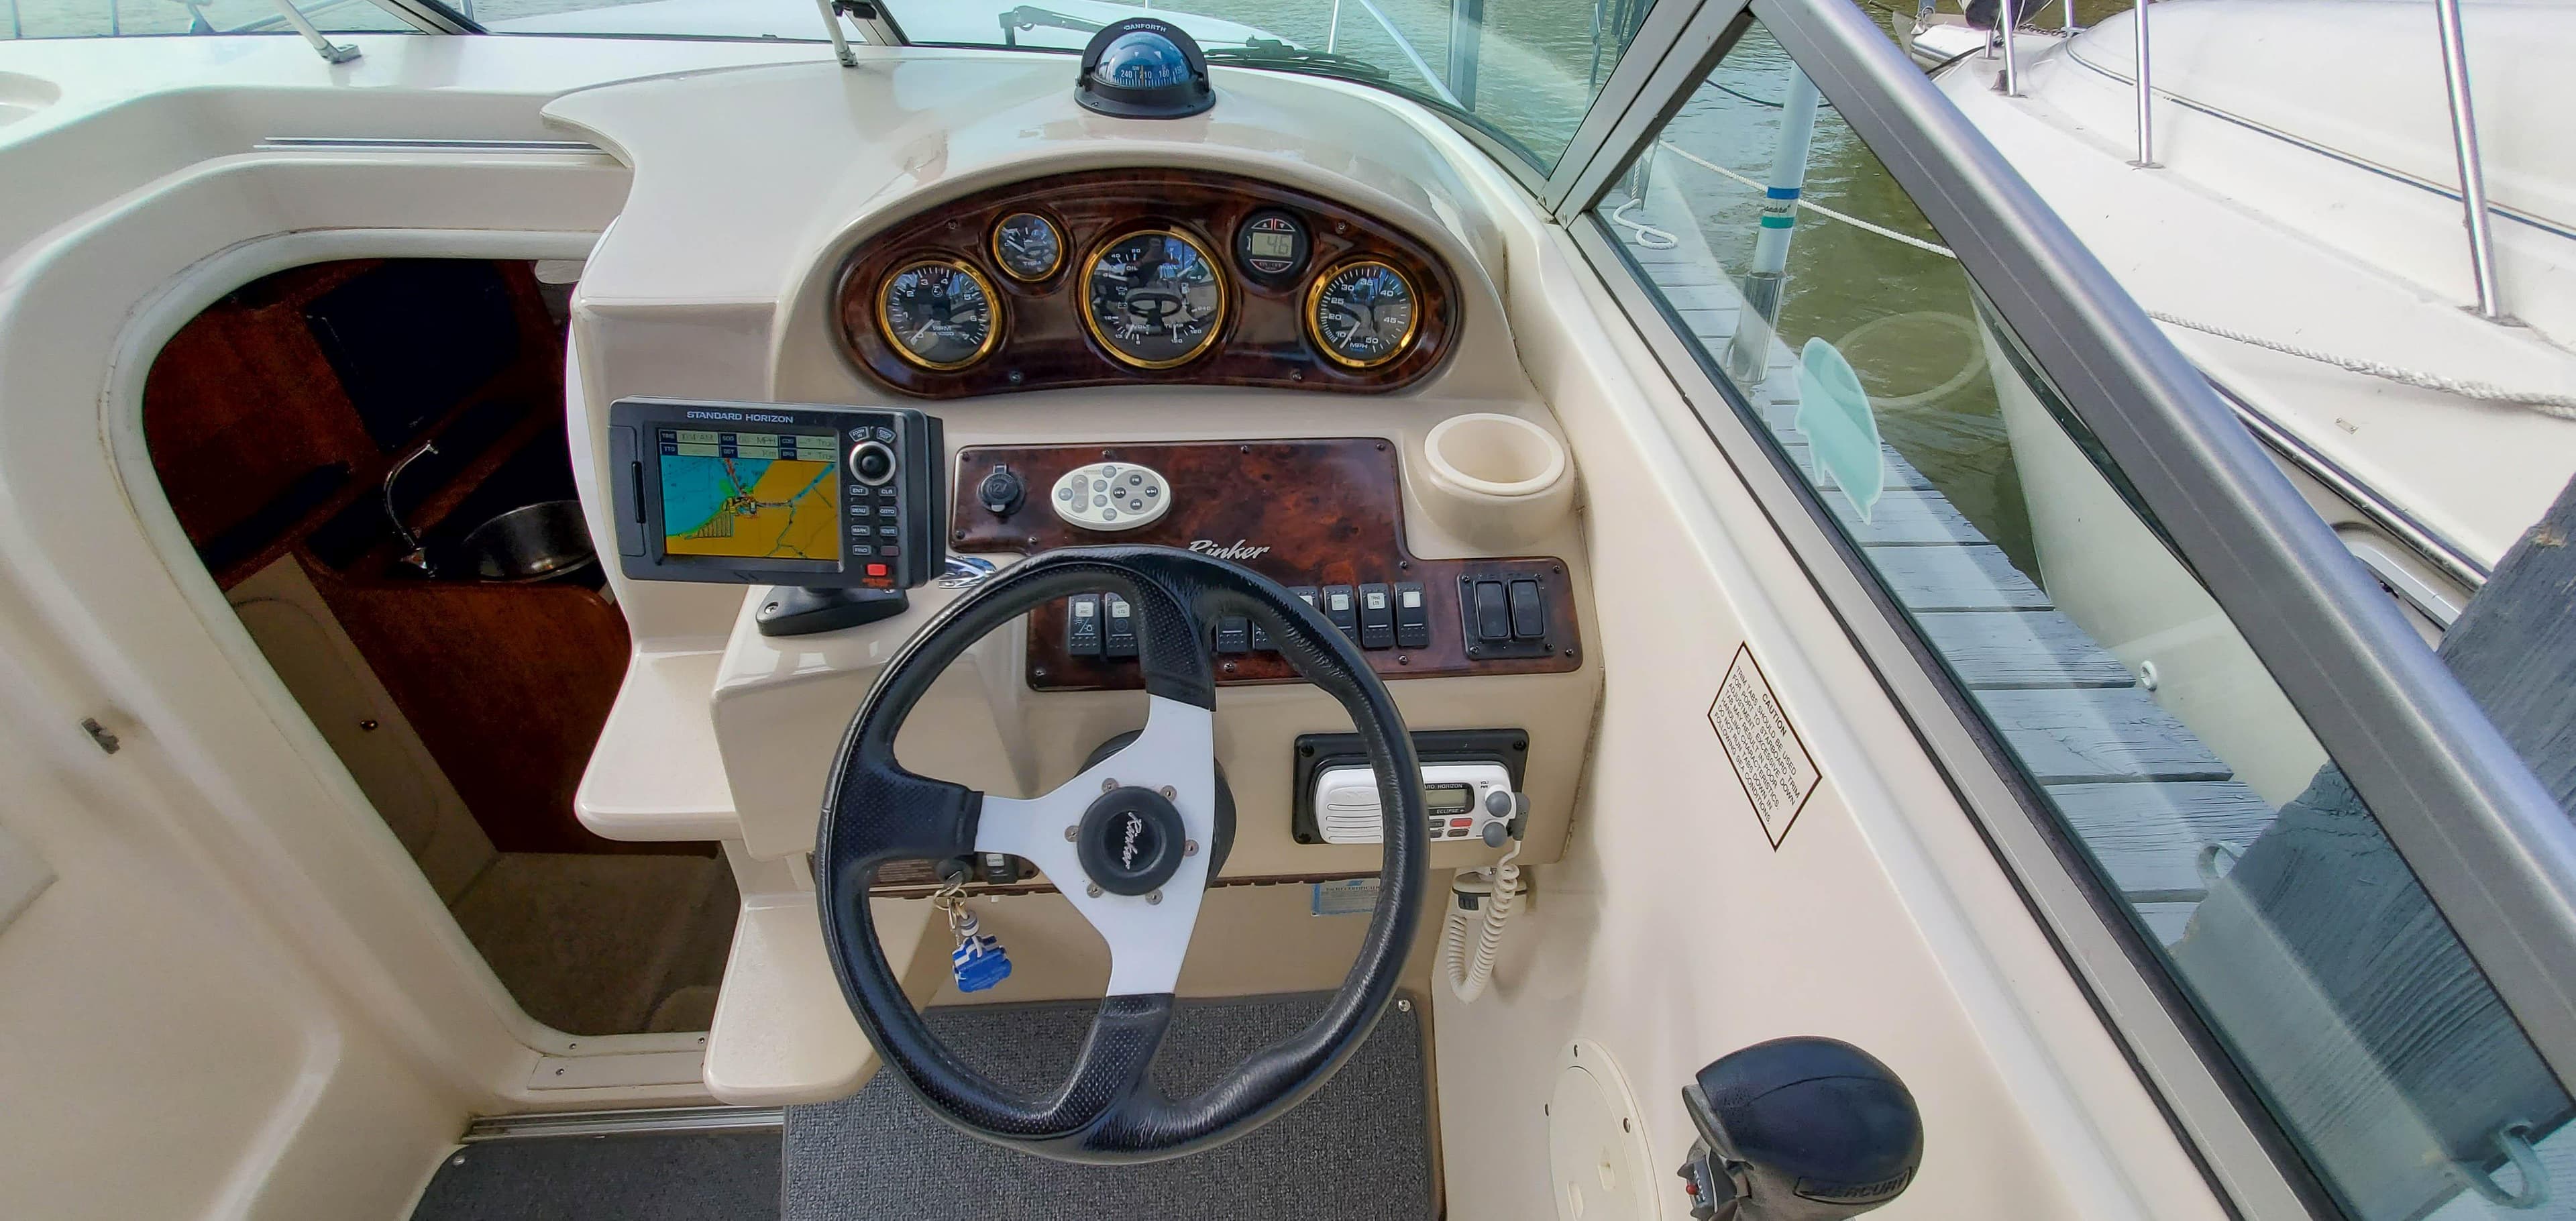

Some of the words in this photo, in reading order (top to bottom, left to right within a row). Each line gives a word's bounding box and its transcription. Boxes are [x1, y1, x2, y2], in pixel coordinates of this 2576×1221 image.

[1124, 23, 1167, 32] DANFORTH
[1121, 70, 1132, 78] 240
[1159, 70, 1170, 78] 180
[686, 411, 742, 421] STANDARD
[745, 414, 794, 424] HORIZON
[1188, 539, 1271, 560] Rinker
[1721, 697, 1741, 735] HANDLING
[1725, 690, 1733, 706] TAB
[1733, 704, 1743, 722] MAY
[1741, 722, 1760, 752] RESULT
[1758, 753, 1764, 764] IN
[1763, 763, 1778, 790] POOR
[1732, 674, 1742, 691] FOR
[1741, 691, 1754, 712] PORT
[1753, 712, 1760, 725] TO
[1760, 726, 1788, 775] STARBOARD
[1787, 775, 1801, 798] TRIM
[1736, 666, 1748, 684] TRIM
[1746, 685, 1758, 706] TABS
[1758, 705, 1776, 739] SHOULD
[1775, 738, 1783, 751] BE
[1782, 751, 1796, 776] USED
[1762, 693, 1787, 737] CAUTION
[1714, 712, 1737, 756] FOLLOWING
[1735, 755, 1745, 773] SEA
[1718, 704, 1725, 717] DO
[1724, 716, 1734, 733] NOT
[1732, 733, 1743, 752] RUN
[1741, 752, 1754, 774] TABS
[1752, 773, 1768, 800] DOWN
[1766, 800, 1773, 811] IN
[1756, 733, 1780, 778] EXCESSIVE
[1780, 778, 1796, 806] DOWN
[1122, 812, 1142, 870] Rinker
